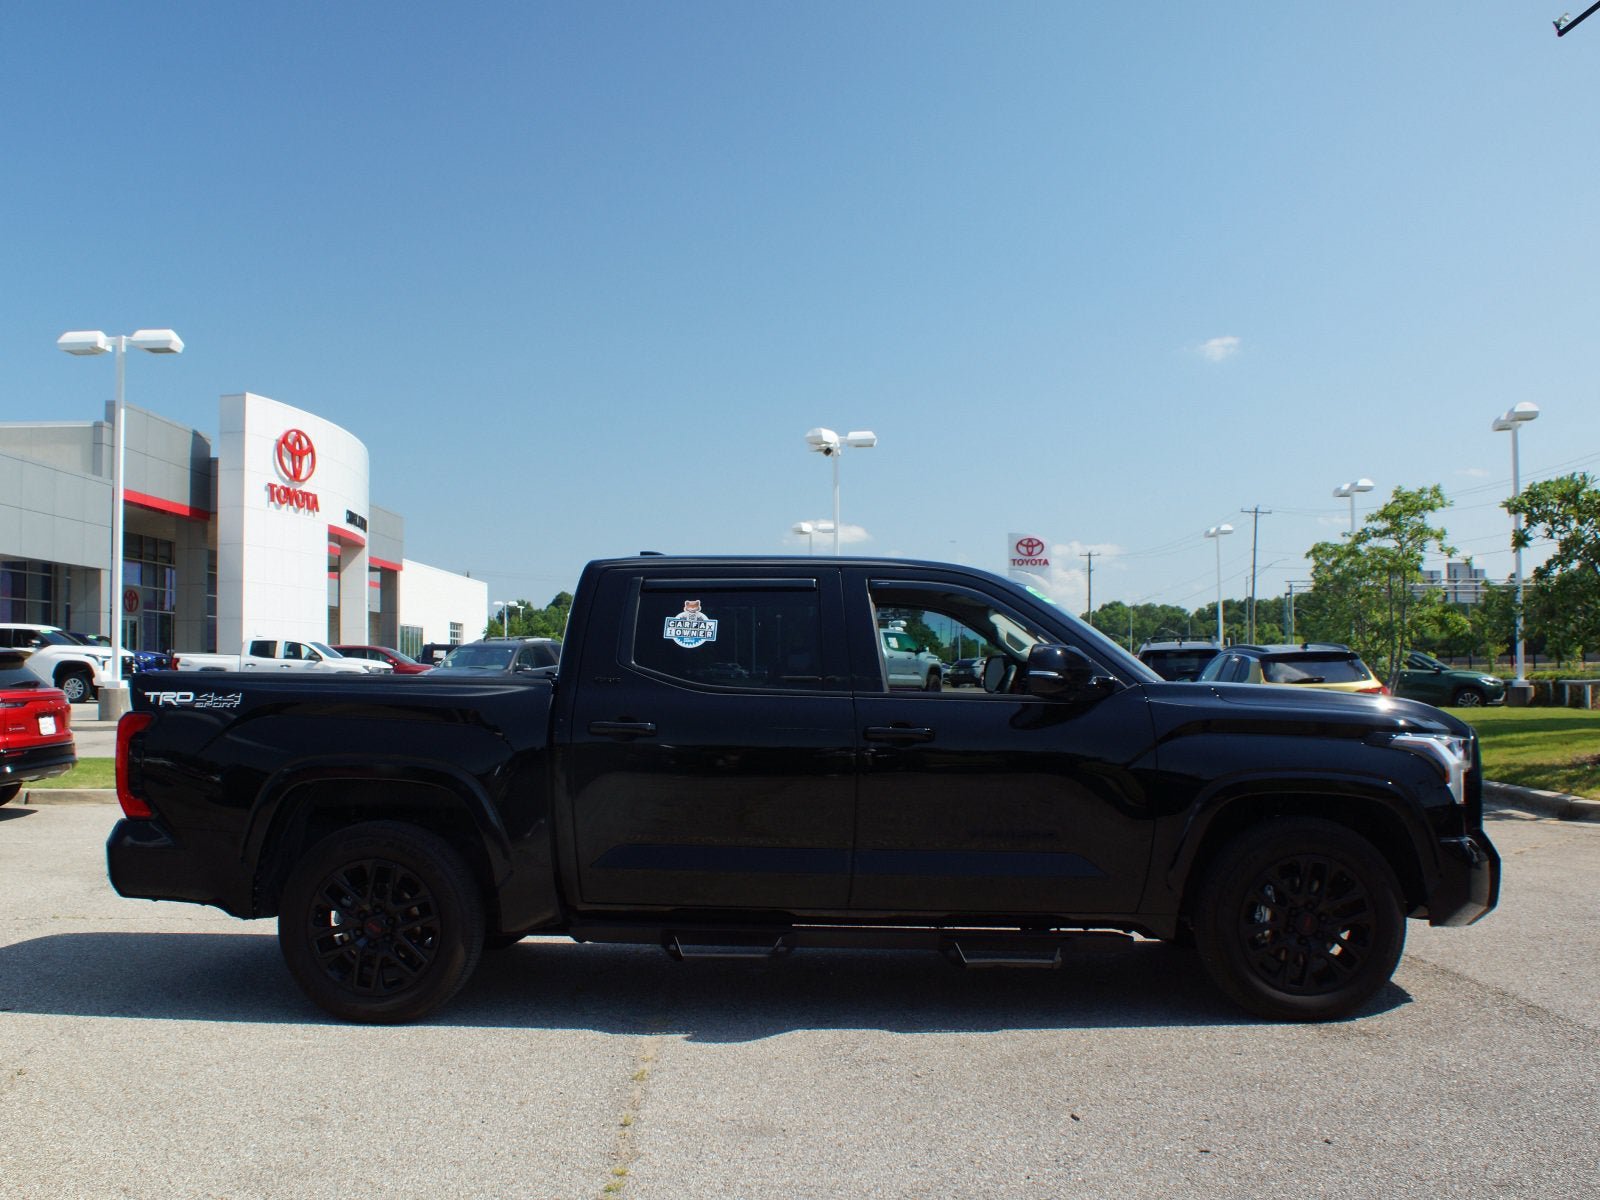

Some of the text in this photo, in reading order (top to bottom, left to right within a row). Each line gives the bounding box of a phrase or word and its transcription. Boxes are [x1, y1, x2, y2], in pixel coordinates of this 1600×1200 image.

[267, 483, 320, 512] TOYOTA
[1011, 558, 1050, 567] TOYOTA
[669, 620, 714, 630] CARFAX
[144, 691, 194, 706] TRD
